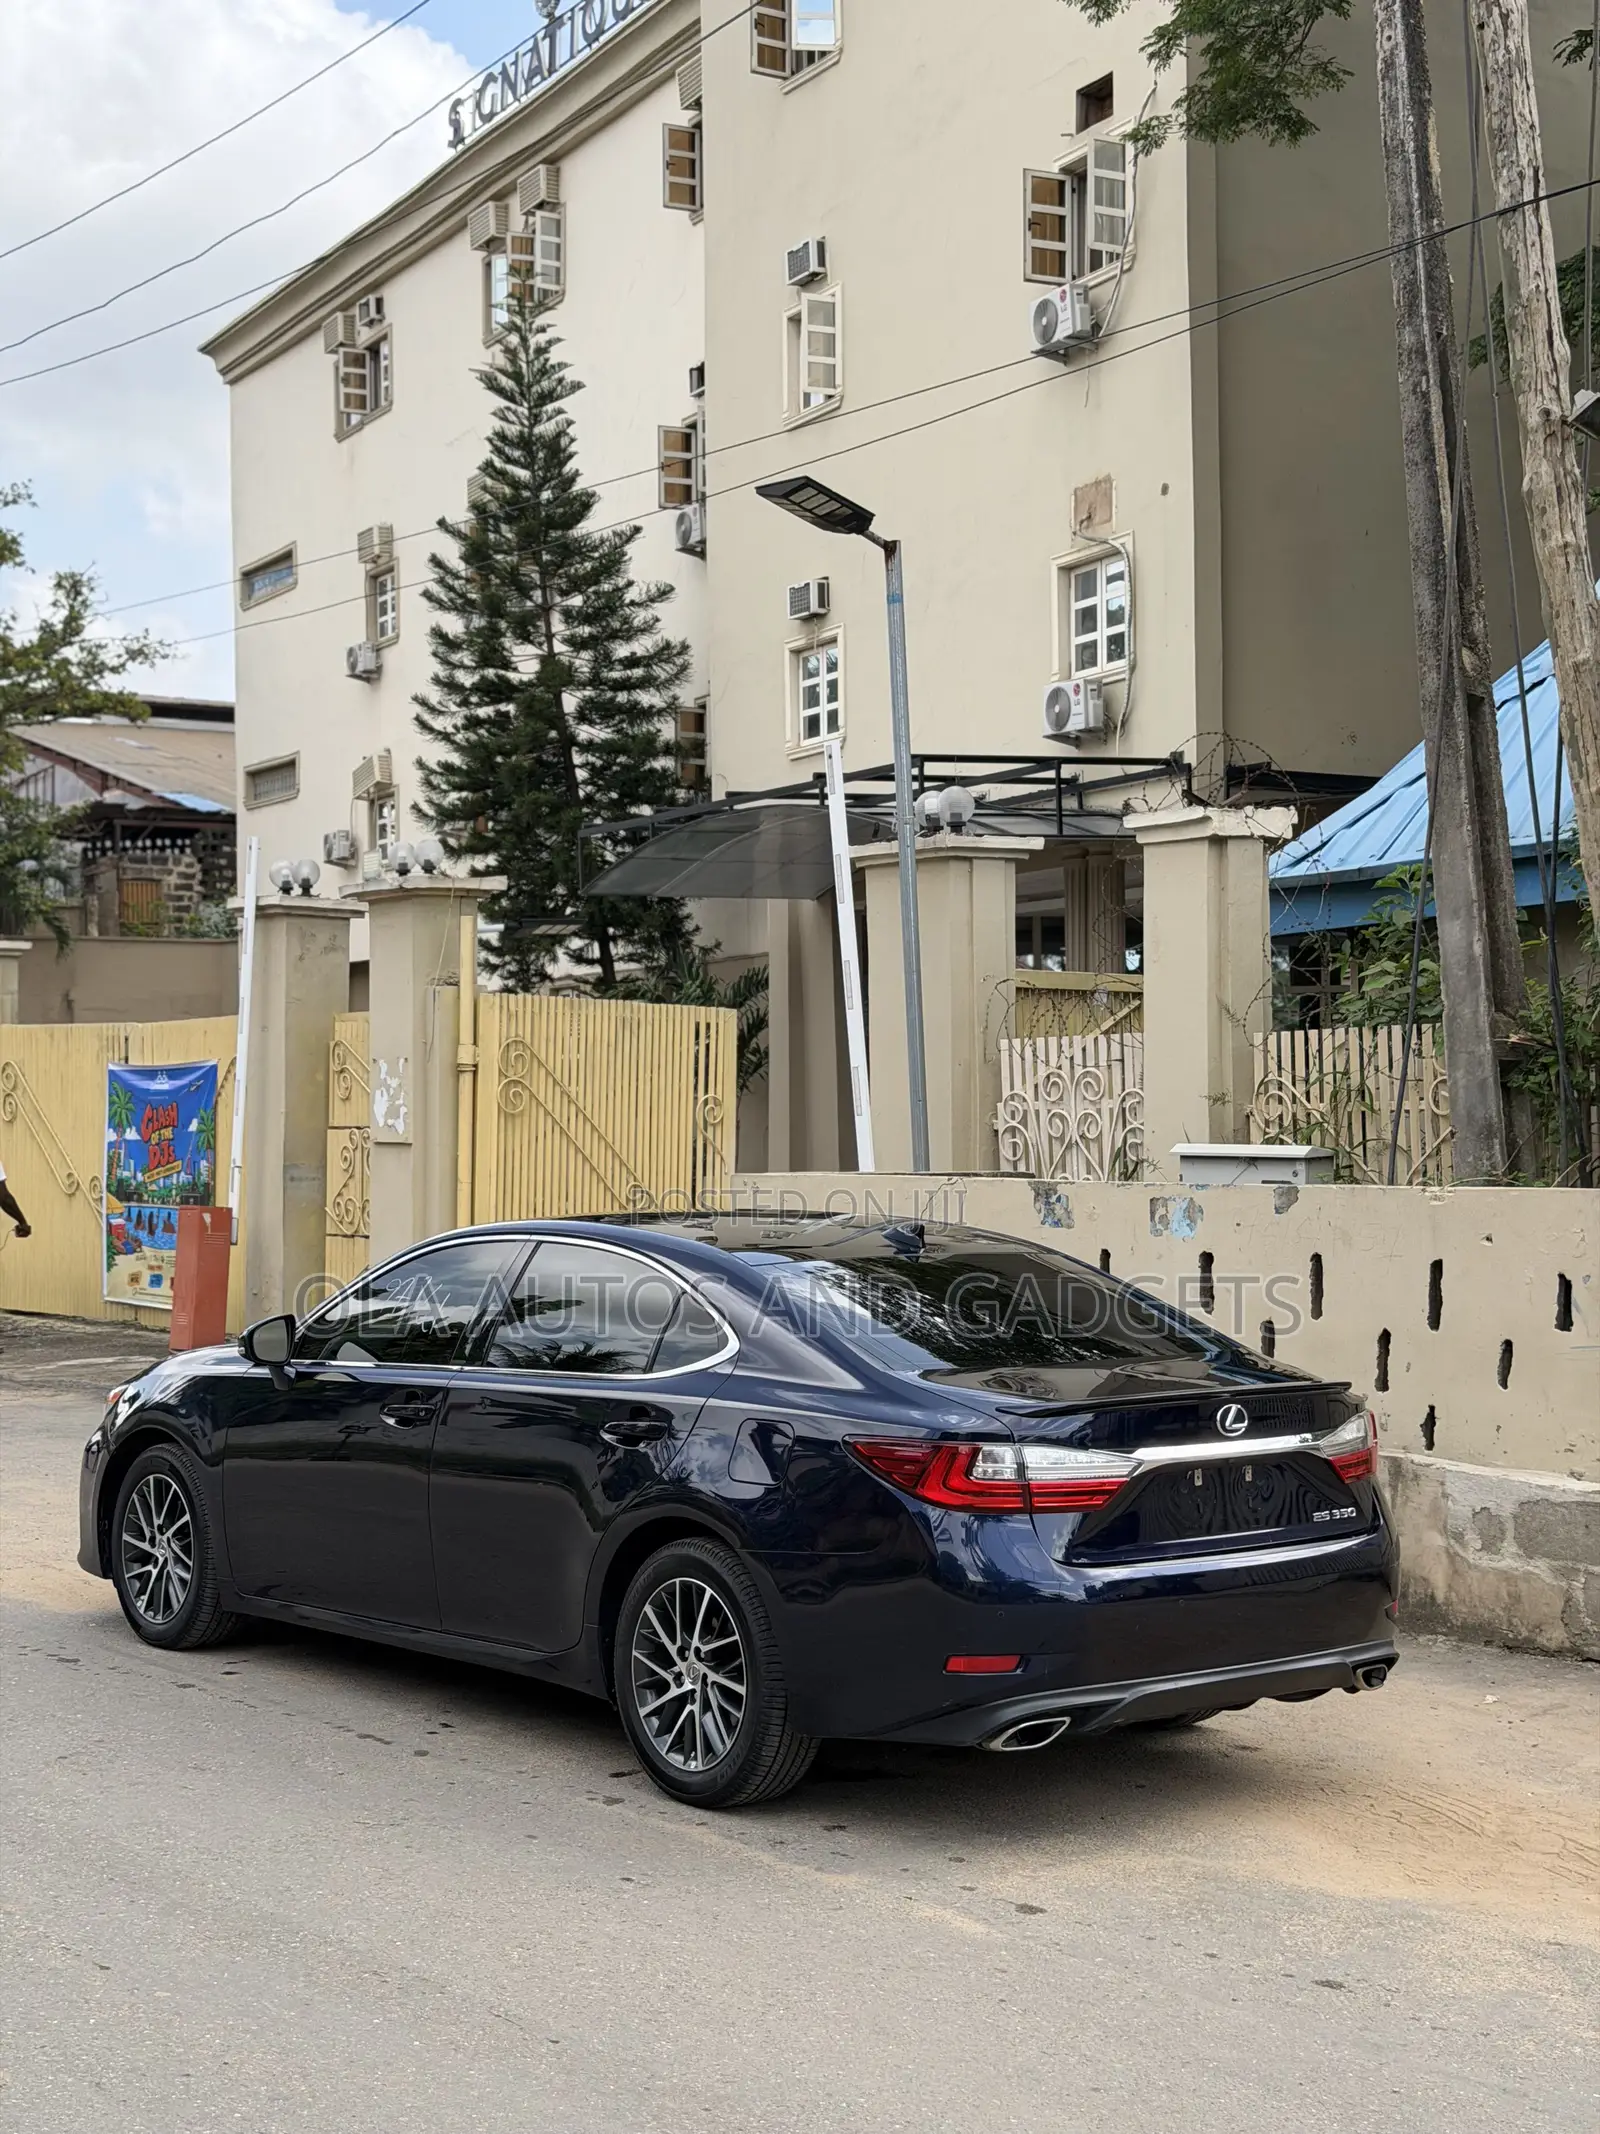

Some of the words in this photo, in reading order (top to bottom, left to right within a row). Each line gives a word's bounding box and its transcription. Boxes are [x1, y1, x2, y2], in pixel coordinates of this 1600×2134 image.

[141, 1101, 179, 1143] CLASH
[160, 1126, 174, 1141] THE
[1312, 1511, 1330, 1522] ES
[1331, 1507, 1356, 1519] 350
